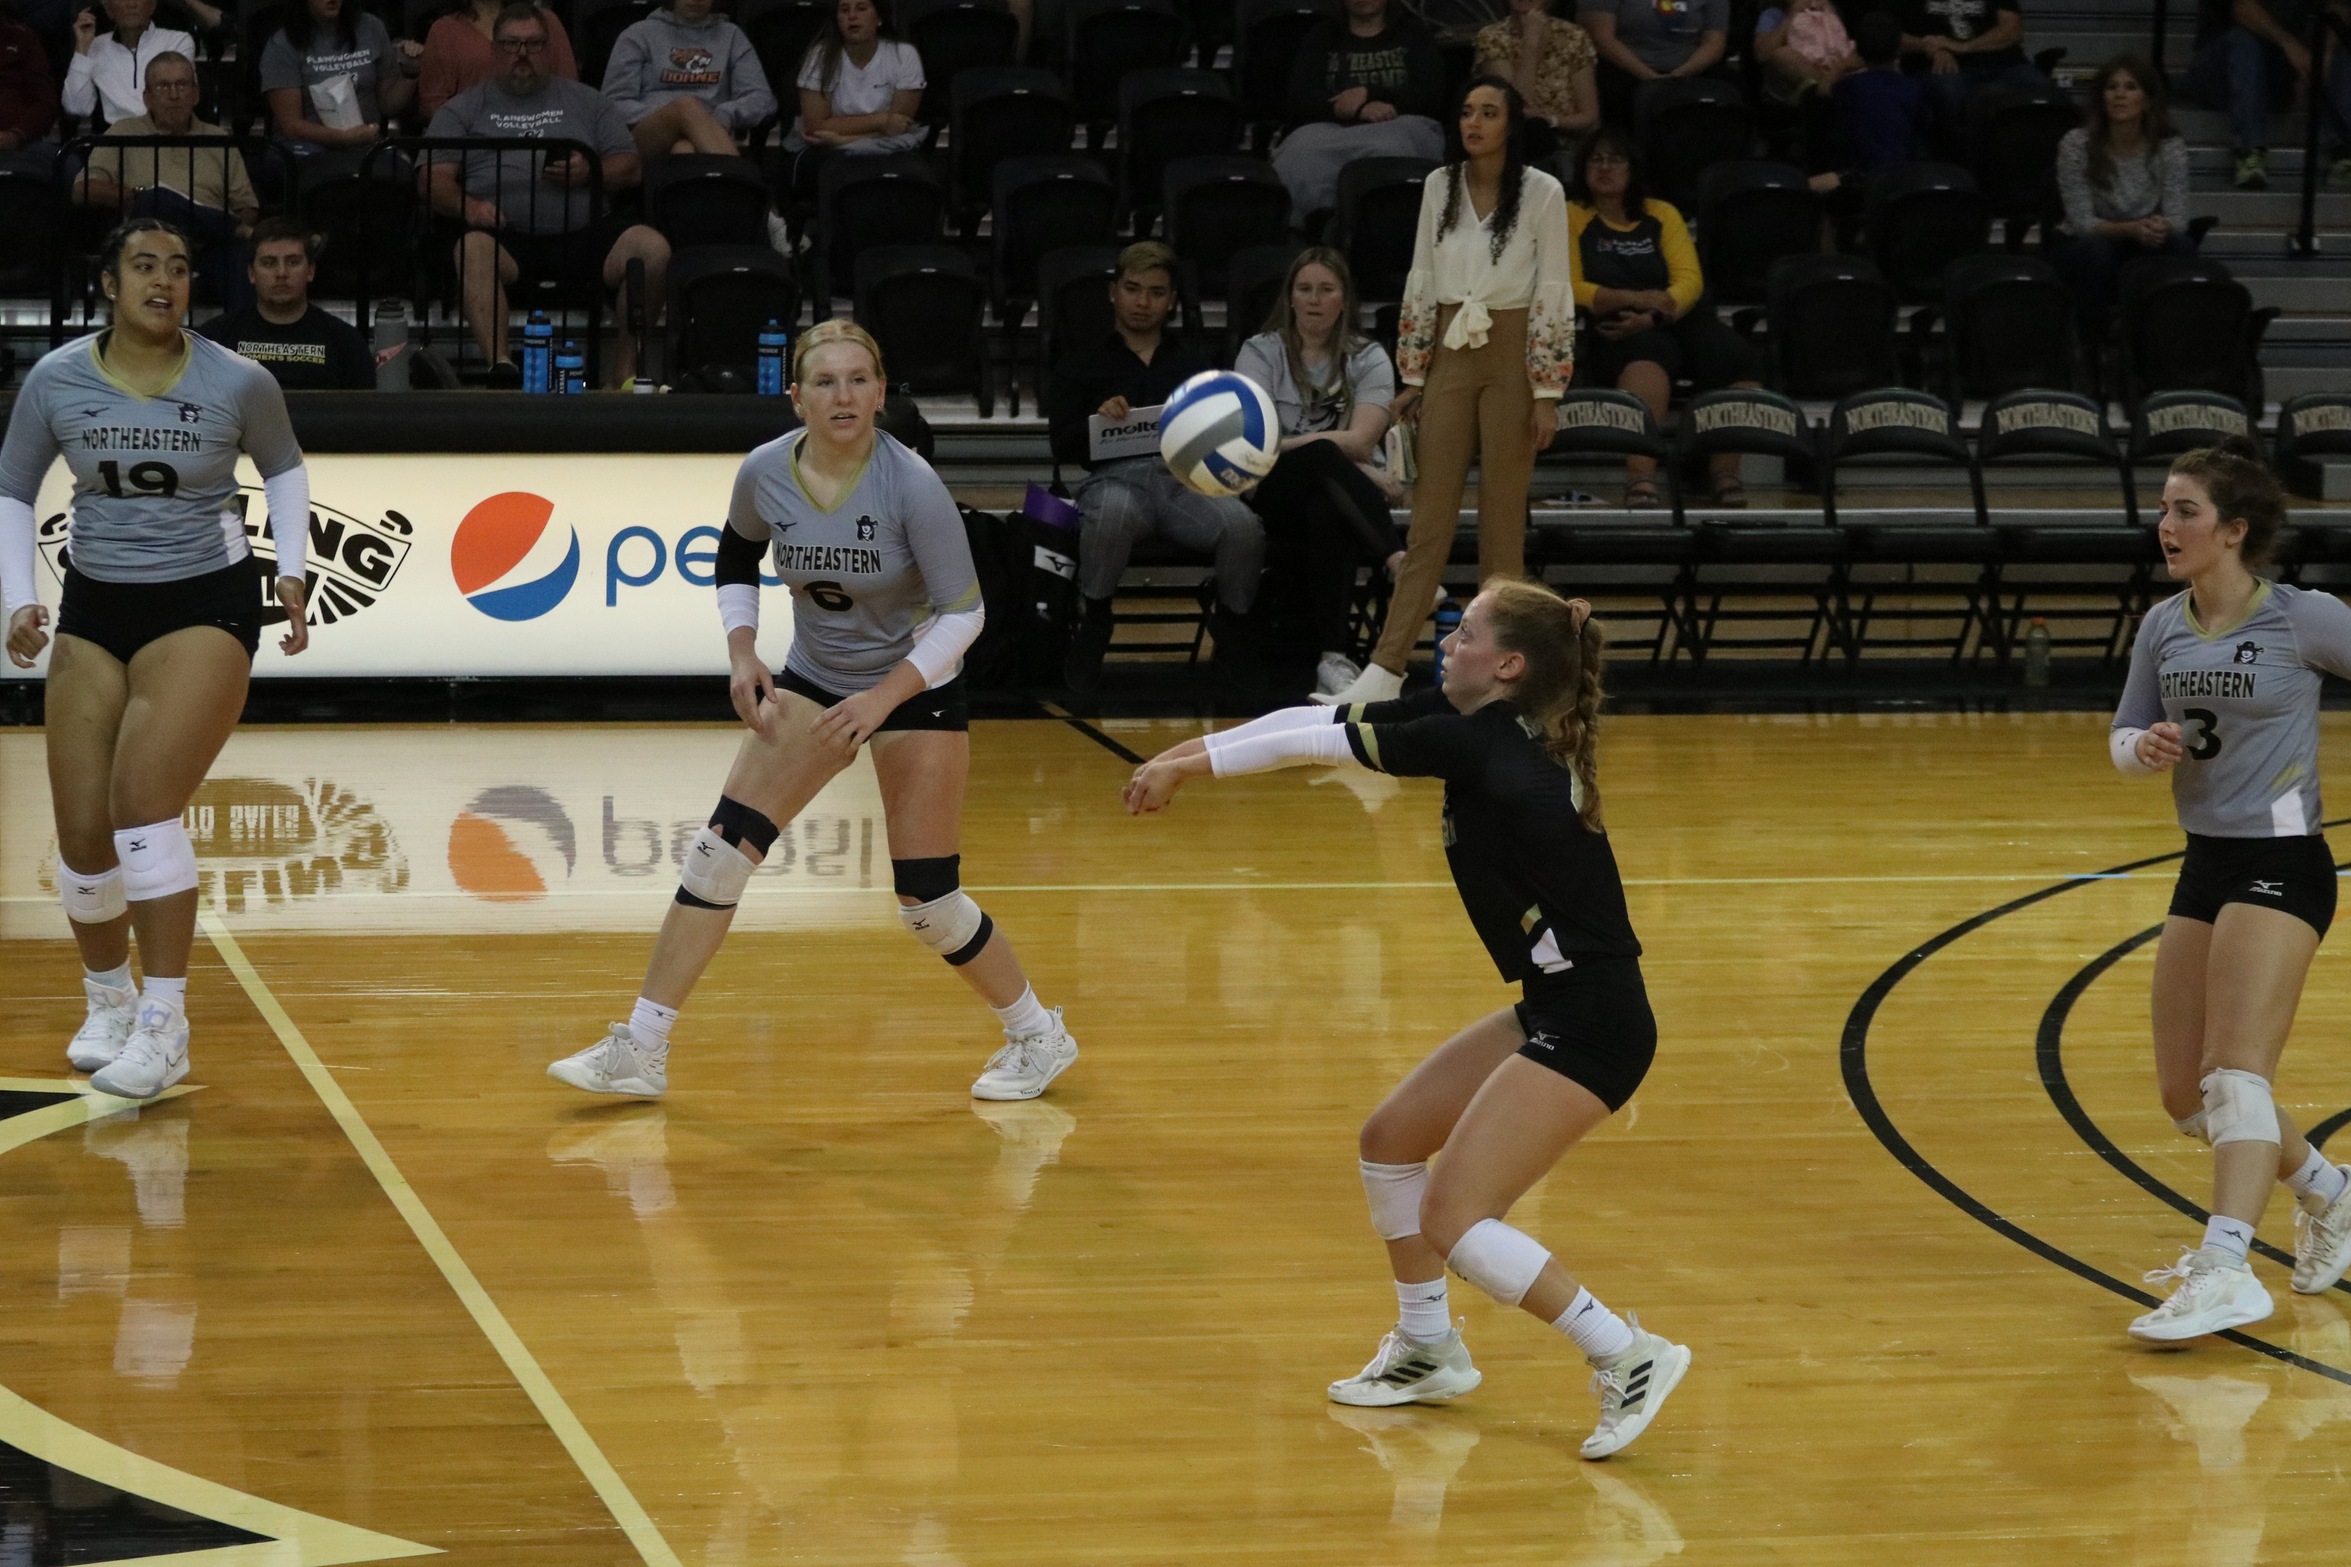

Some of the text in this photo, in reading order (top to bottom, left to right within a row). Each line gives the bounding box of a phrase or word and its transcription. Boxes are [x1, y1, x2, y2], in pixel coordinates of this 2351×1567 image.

[312, 58, 372, 71] VOLLEYBALL
[490, 110, 563, 121] PLAINSWOMEN
[496, 117, 562, 129] VOLLEYBALL
[237, 341, 326, 358] NORTHEASTERN
[242, 353, 326, 365] OMEN'S SOCCER
[1102, 421, 1159, 438] molte
[1693, 402, 1798, 437] NORTHEASTERN
[82, 427, 201, 452] NORTHEASTERN
[98, 460, 178, 498] 19
[776, 541, 882, 574] NORTHEASTERN
[803, 580, 853, 611] 6
[2183, 708, 2222, 761] 3
